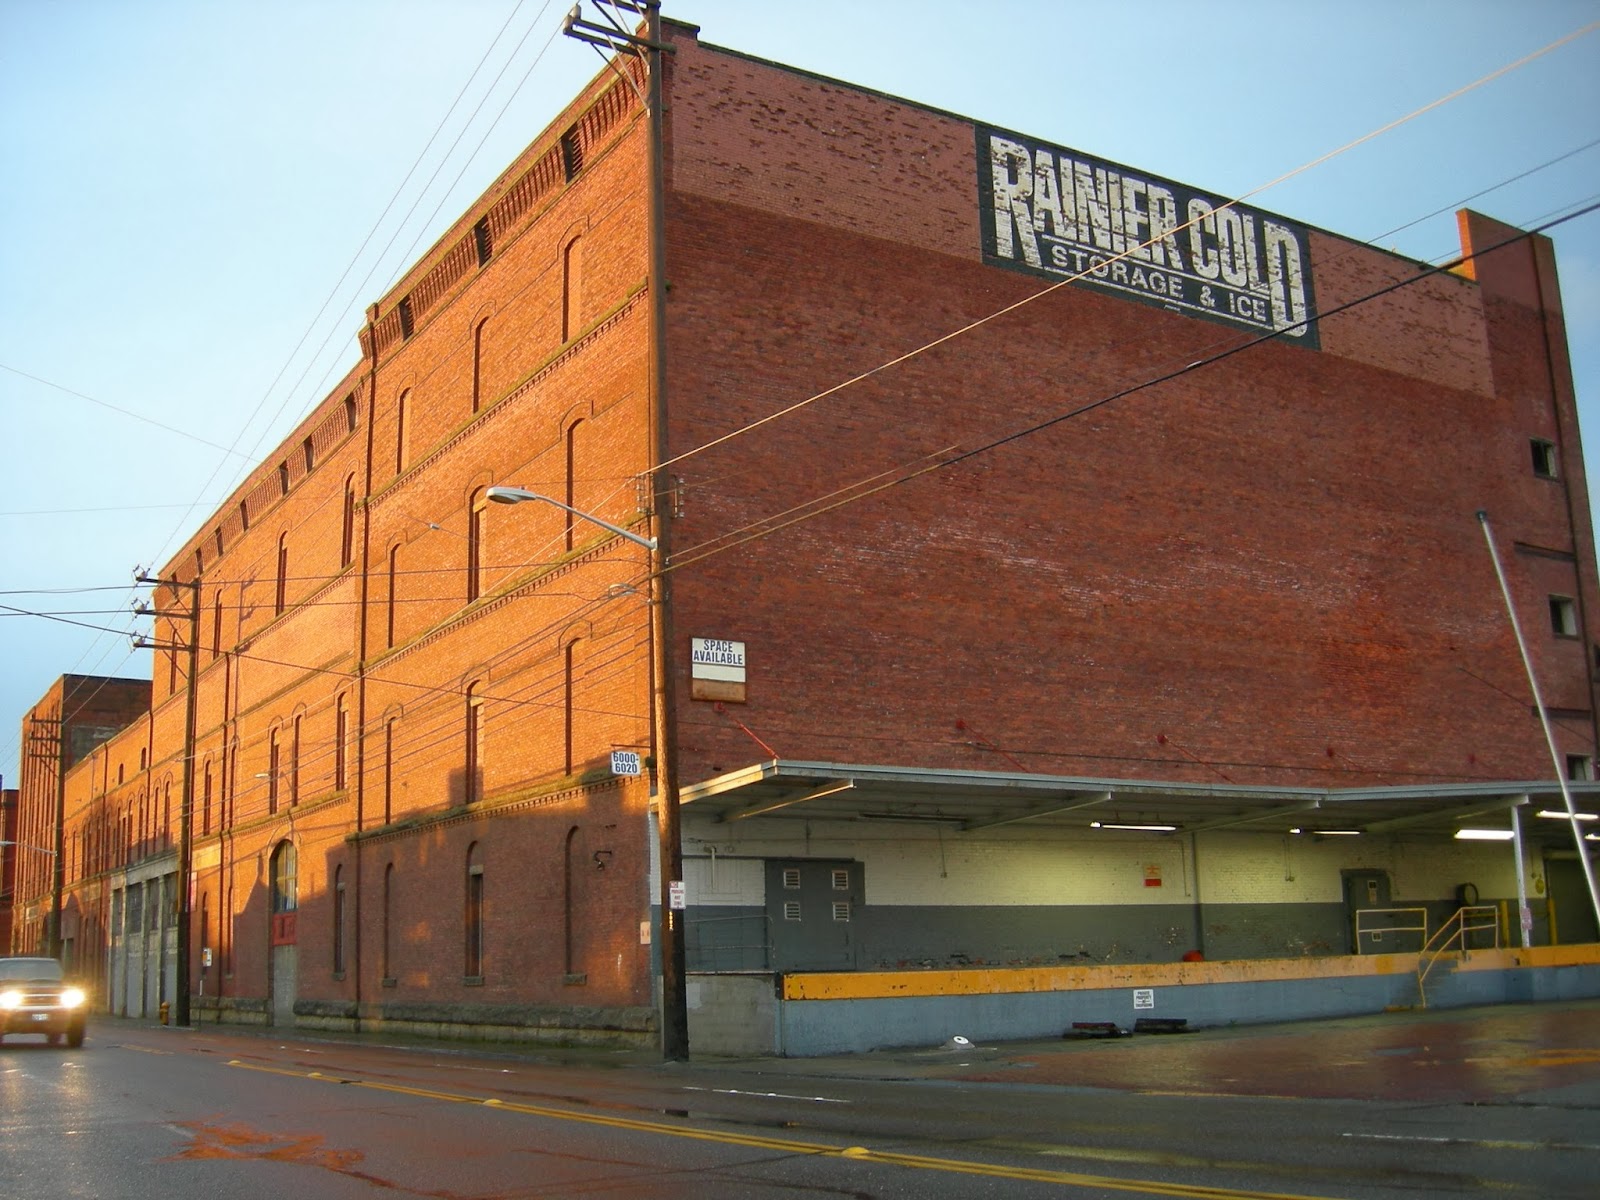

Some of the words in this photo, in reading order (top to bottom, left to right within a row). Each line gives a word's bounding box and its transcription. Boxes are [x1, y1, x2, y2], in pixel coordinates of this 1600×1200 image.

[990, 135, 1184, 270] RAINIER
[1187, 200, 1307, 338] COLD
[1051, 245, 1184, 299] STORAGE
[1200, 285, 1215, 307] &
[1229, 292, 1268, 322] ICE
[704, 640, 733, 652] SPACE
[693, 650, 743, 665] AVAILABLE
[615, 763, 638, 774] 6020
